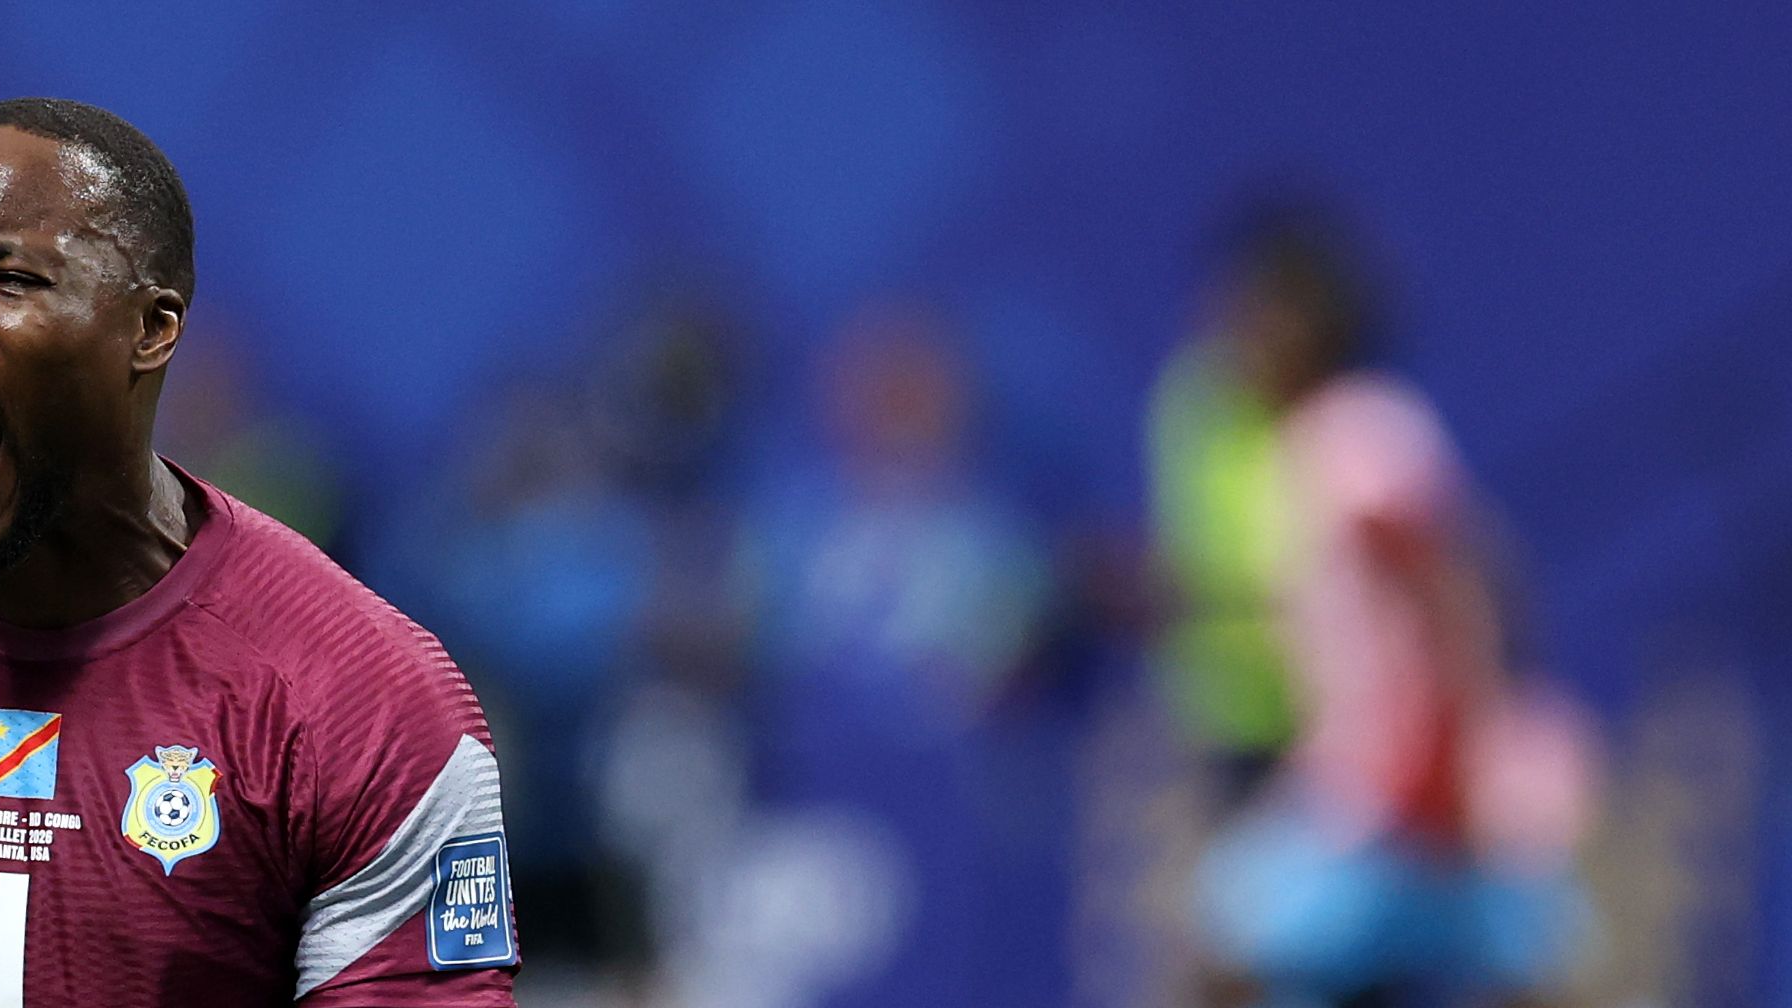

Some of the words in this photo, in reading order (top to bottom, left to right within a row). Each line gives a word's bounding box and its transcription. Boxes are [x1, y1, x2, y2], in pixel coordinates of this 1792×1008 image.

[44, 813, 81, 829] CONGO
[29, 830, 53, 844] 2026
[138, 830, 200, 851] FECOFA
[30, 847, 50, 861] USA
[446, 877, 495, 905] UNITES
[440, 907, 469, 931] the
[464, 933, 484, 946] FIFA
